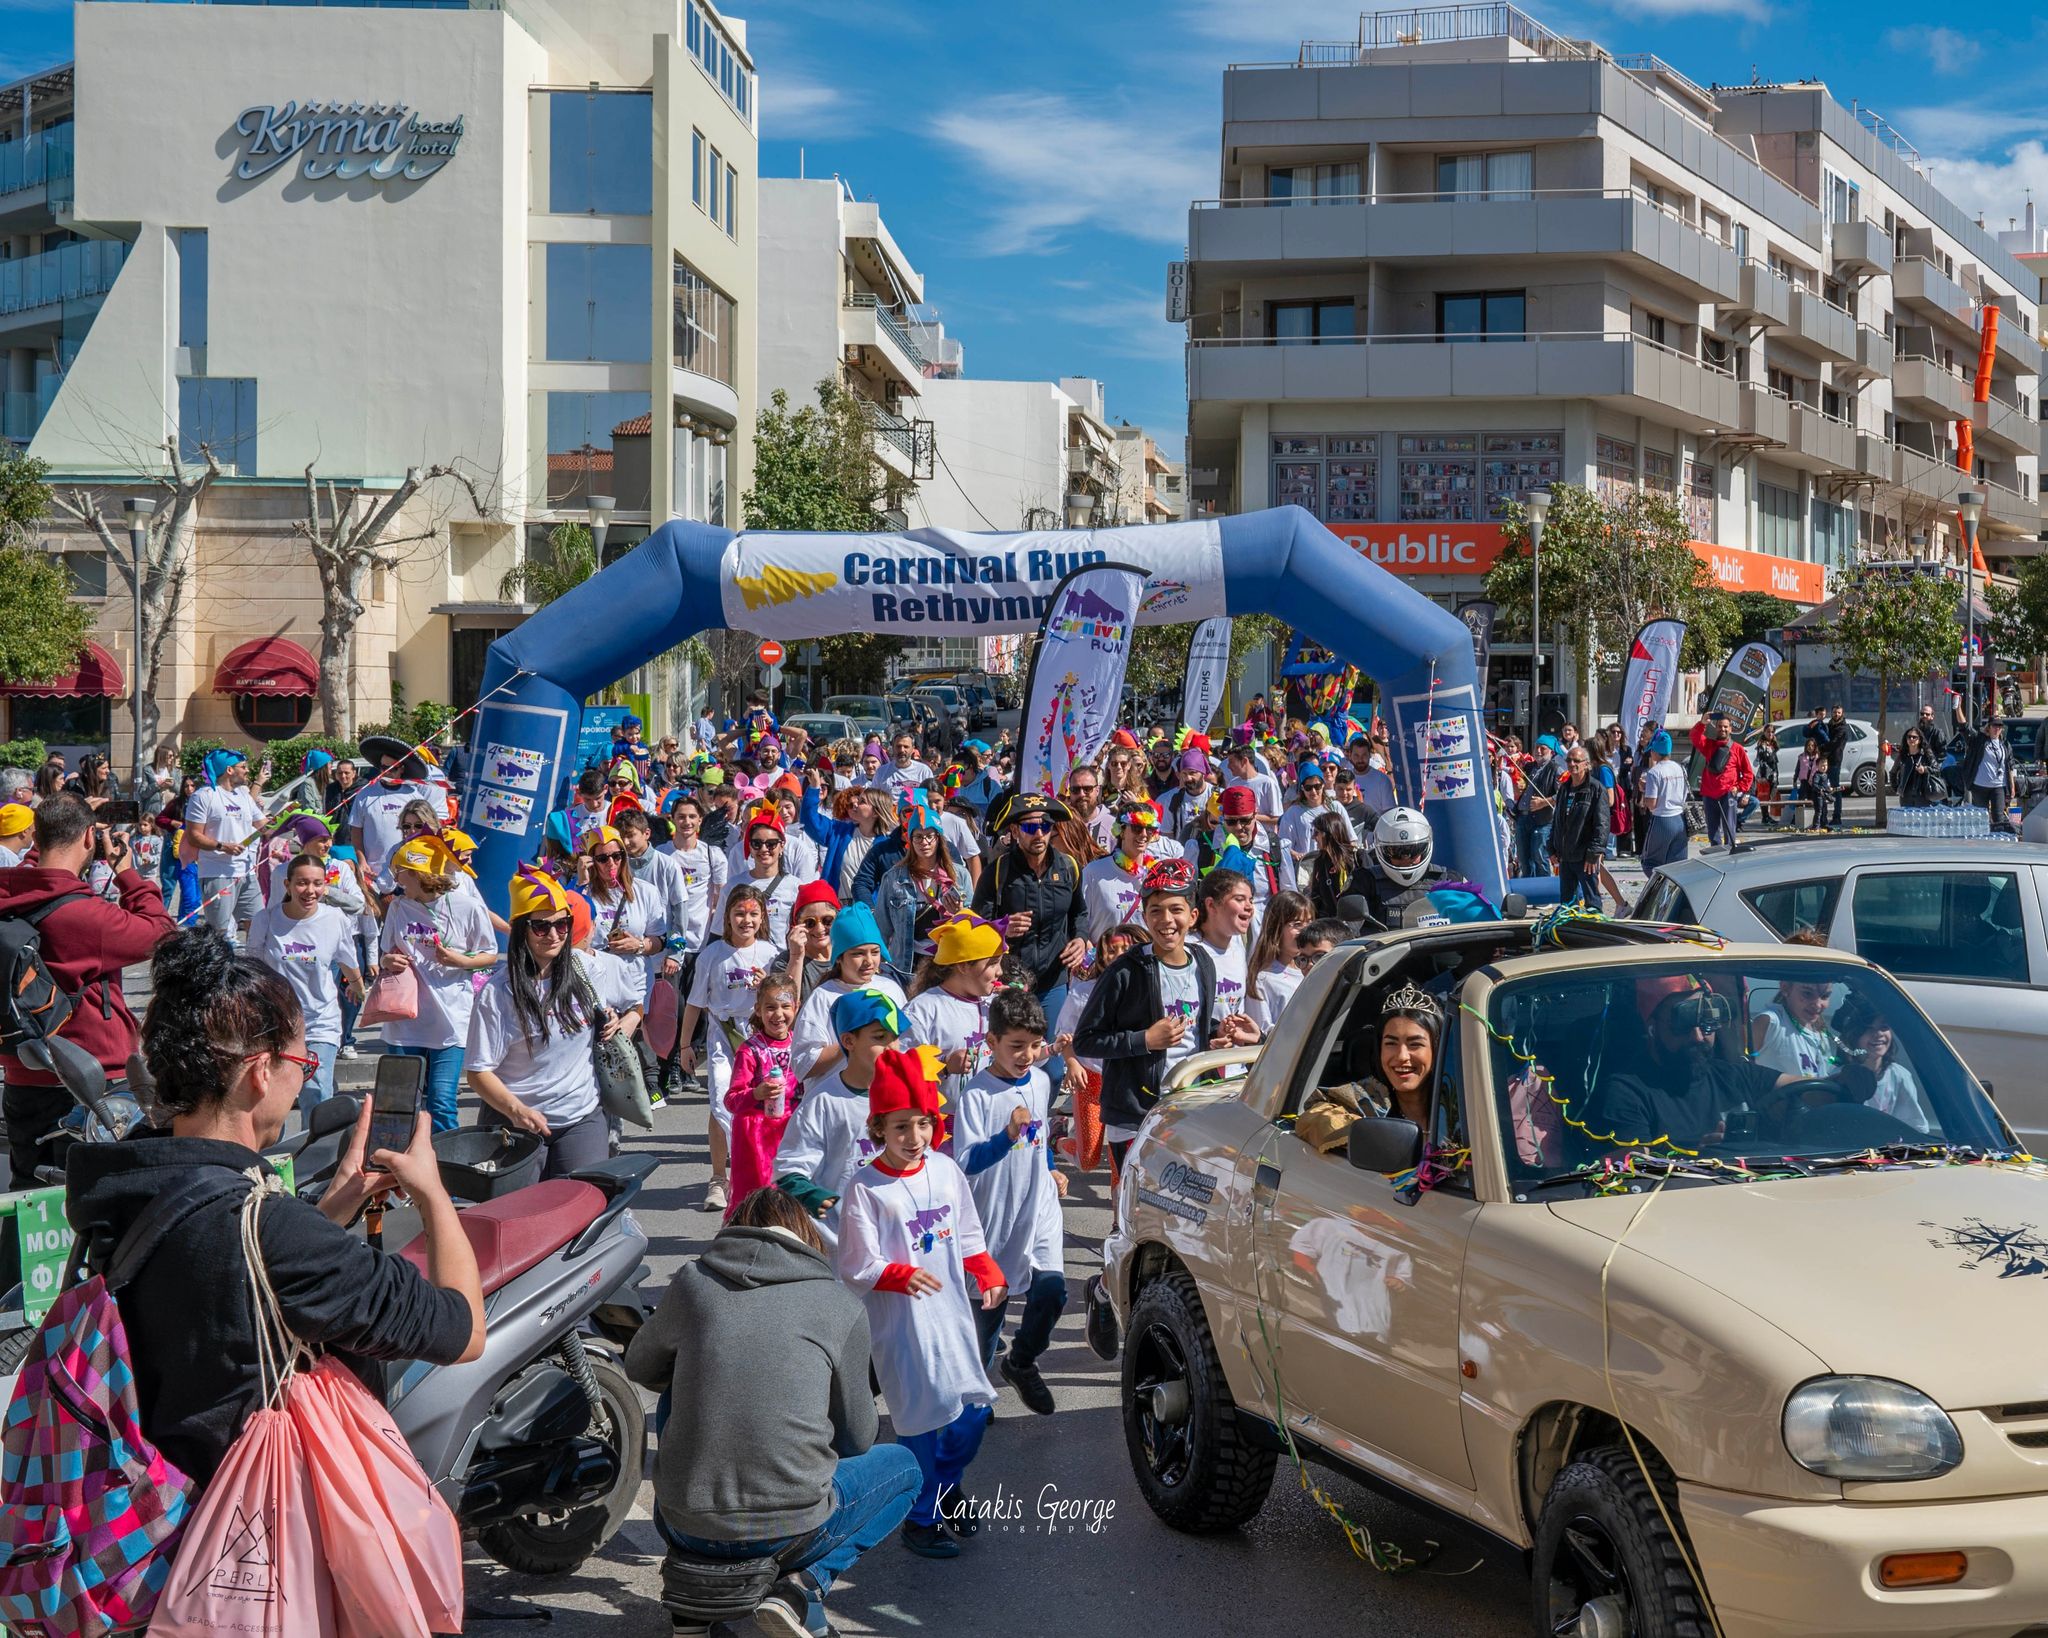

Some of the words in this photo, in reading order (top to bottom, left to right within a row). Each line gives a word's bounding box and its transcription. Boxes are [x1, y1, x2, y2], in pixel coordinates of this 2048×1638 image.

[407, 111, 464, 136] beach
[236, 100, 402, 180] Kyma
[407, 135, 461, 156] hotel
[1170, 263, 1184, 320] HOTEL
[1343, 534, 1476, 564] Public
[843, 550, 1017, 586] Carnival
[1028, 548, 1107, 582] Run
[1712, 554, 1745, 585] Public
[1771, 566, 1800, 593] Public
[872, 592, 1050, 624] Rethymn
[1051, 615, 1126, 641] Carnival
[1091, 640, 1123, 655] RUN
[1200, 670, 1211, 701] ITEMS
[1716, 703, 1747, 720] ANTIKA
[488, 745, 501, 760] 4
[498, 747, 541, 761] Carnival
[1432, 761, 1471, 771] Carnival
[478, 788, 491, 802] 4
[488, 790, 530, 805] Carnival
[213, 1568, 273, 1588] PERL
[187, 1615, 215, 1629] BEADS
